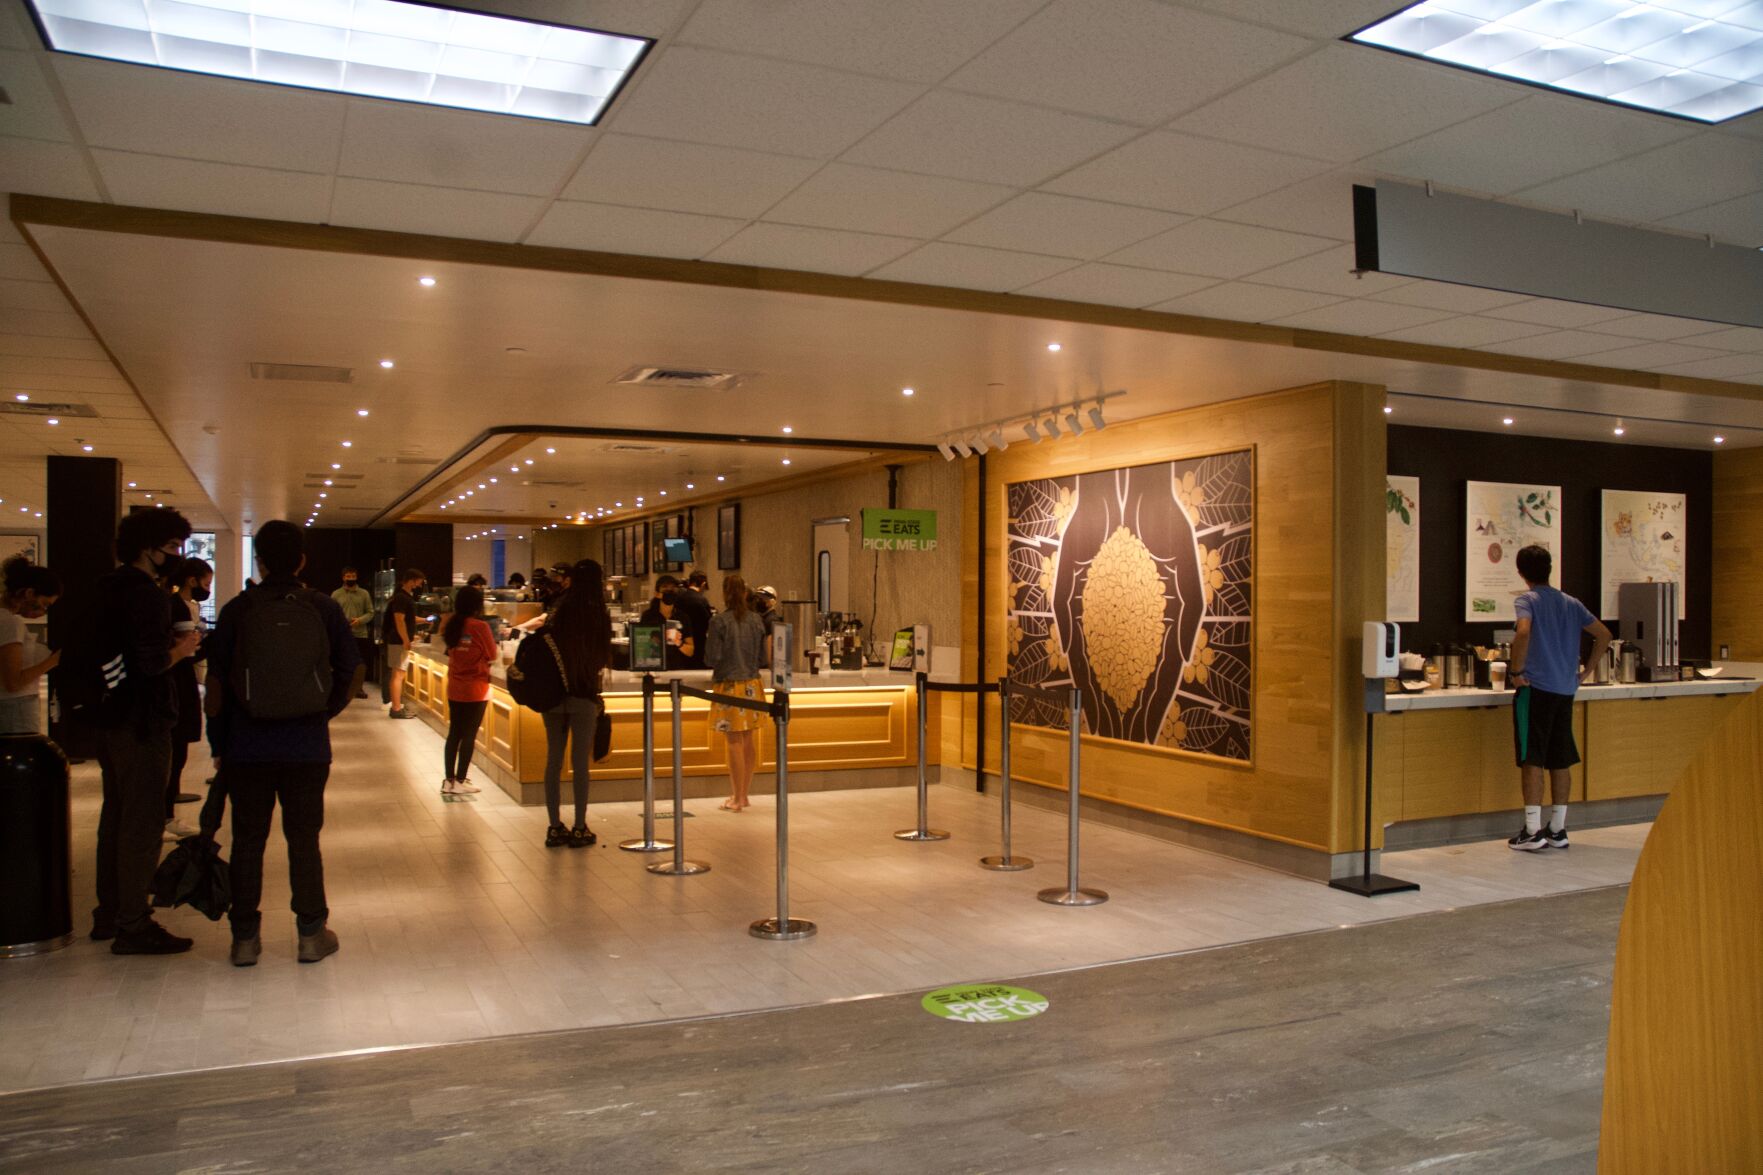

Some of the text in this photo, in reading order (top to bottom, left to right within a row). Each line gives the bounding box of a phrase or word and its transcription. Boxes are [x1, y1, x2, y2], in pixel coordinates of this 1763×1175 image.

[893, 524, 920, 535] EATS
[863, 537, 937, 551] PICK ME UP
[944, 995, 1019, 1014] PICK
[945, 1000, 1050, 1023] ME UP
